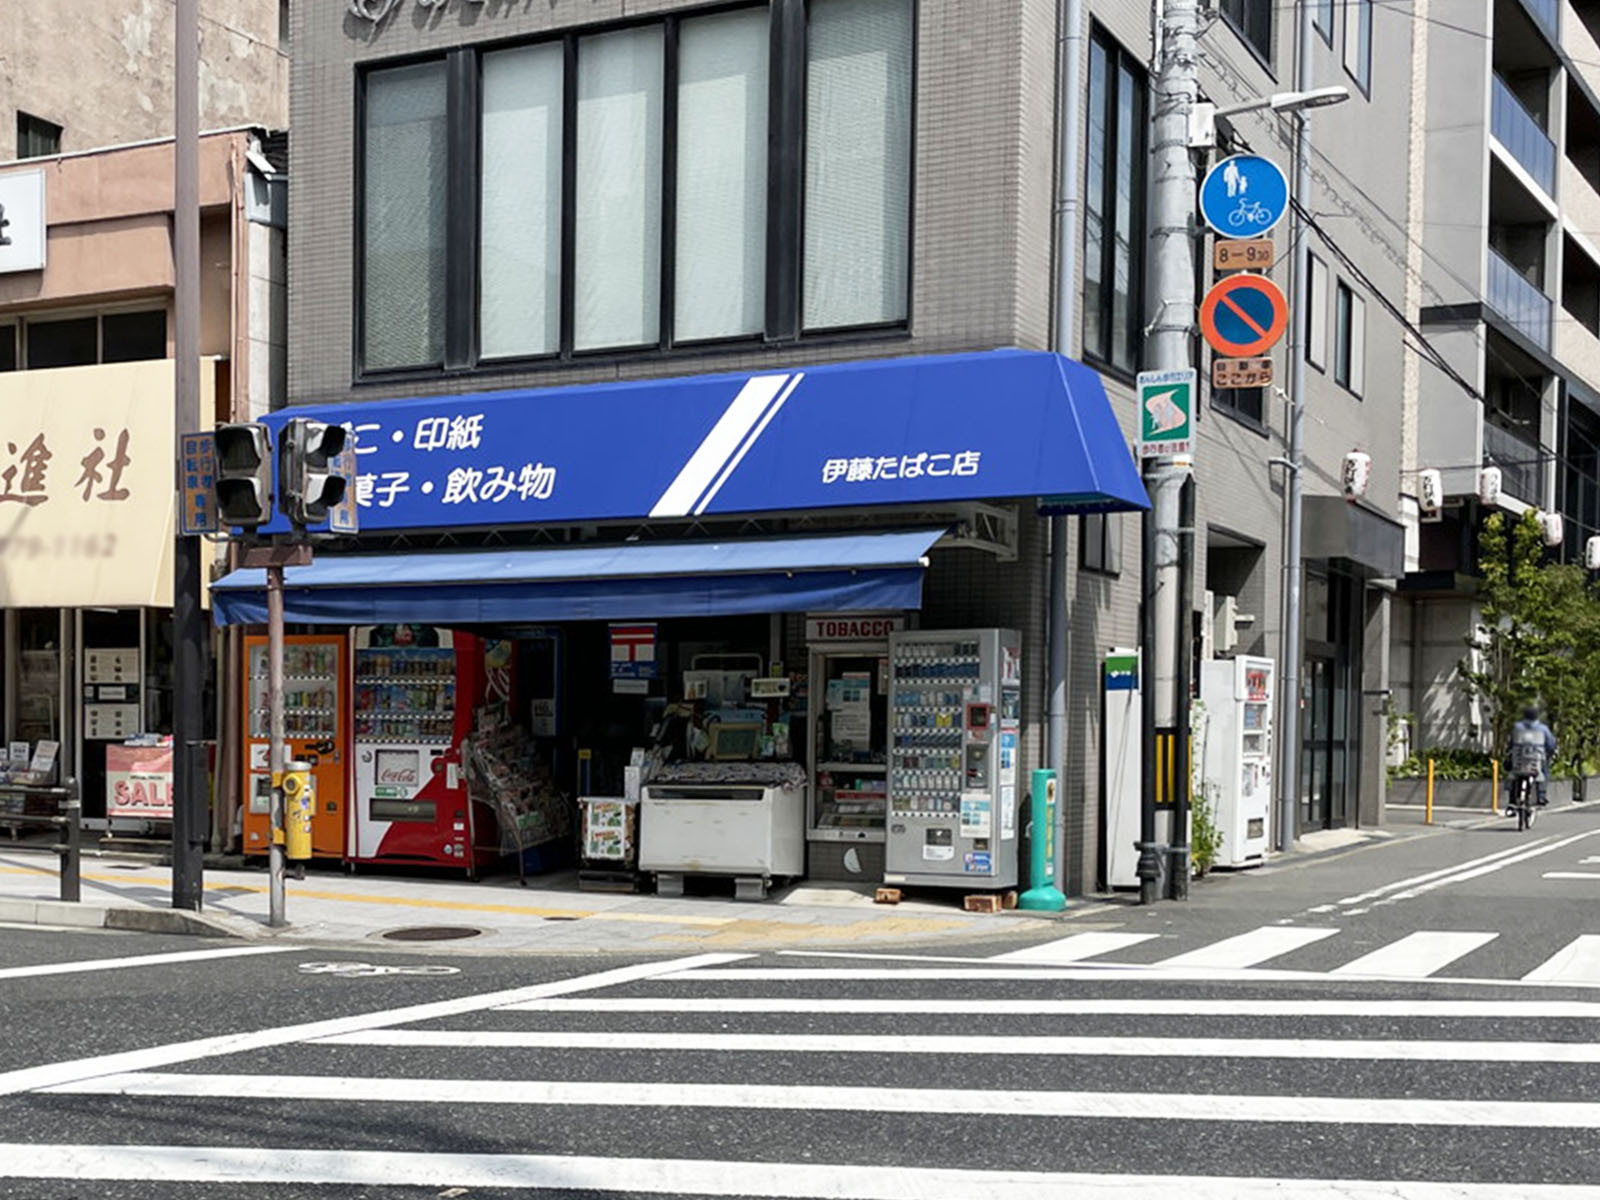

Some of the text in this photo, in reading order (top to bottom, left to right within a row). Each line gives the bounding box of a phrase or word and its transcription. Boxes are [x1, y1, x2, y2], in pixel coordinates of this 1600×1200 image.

[1216, 371, 1271, 386] ここから
[822, 450, 981, 484] 伊藤たばこ店
[816, 620, 894, 637] TOBACCO
